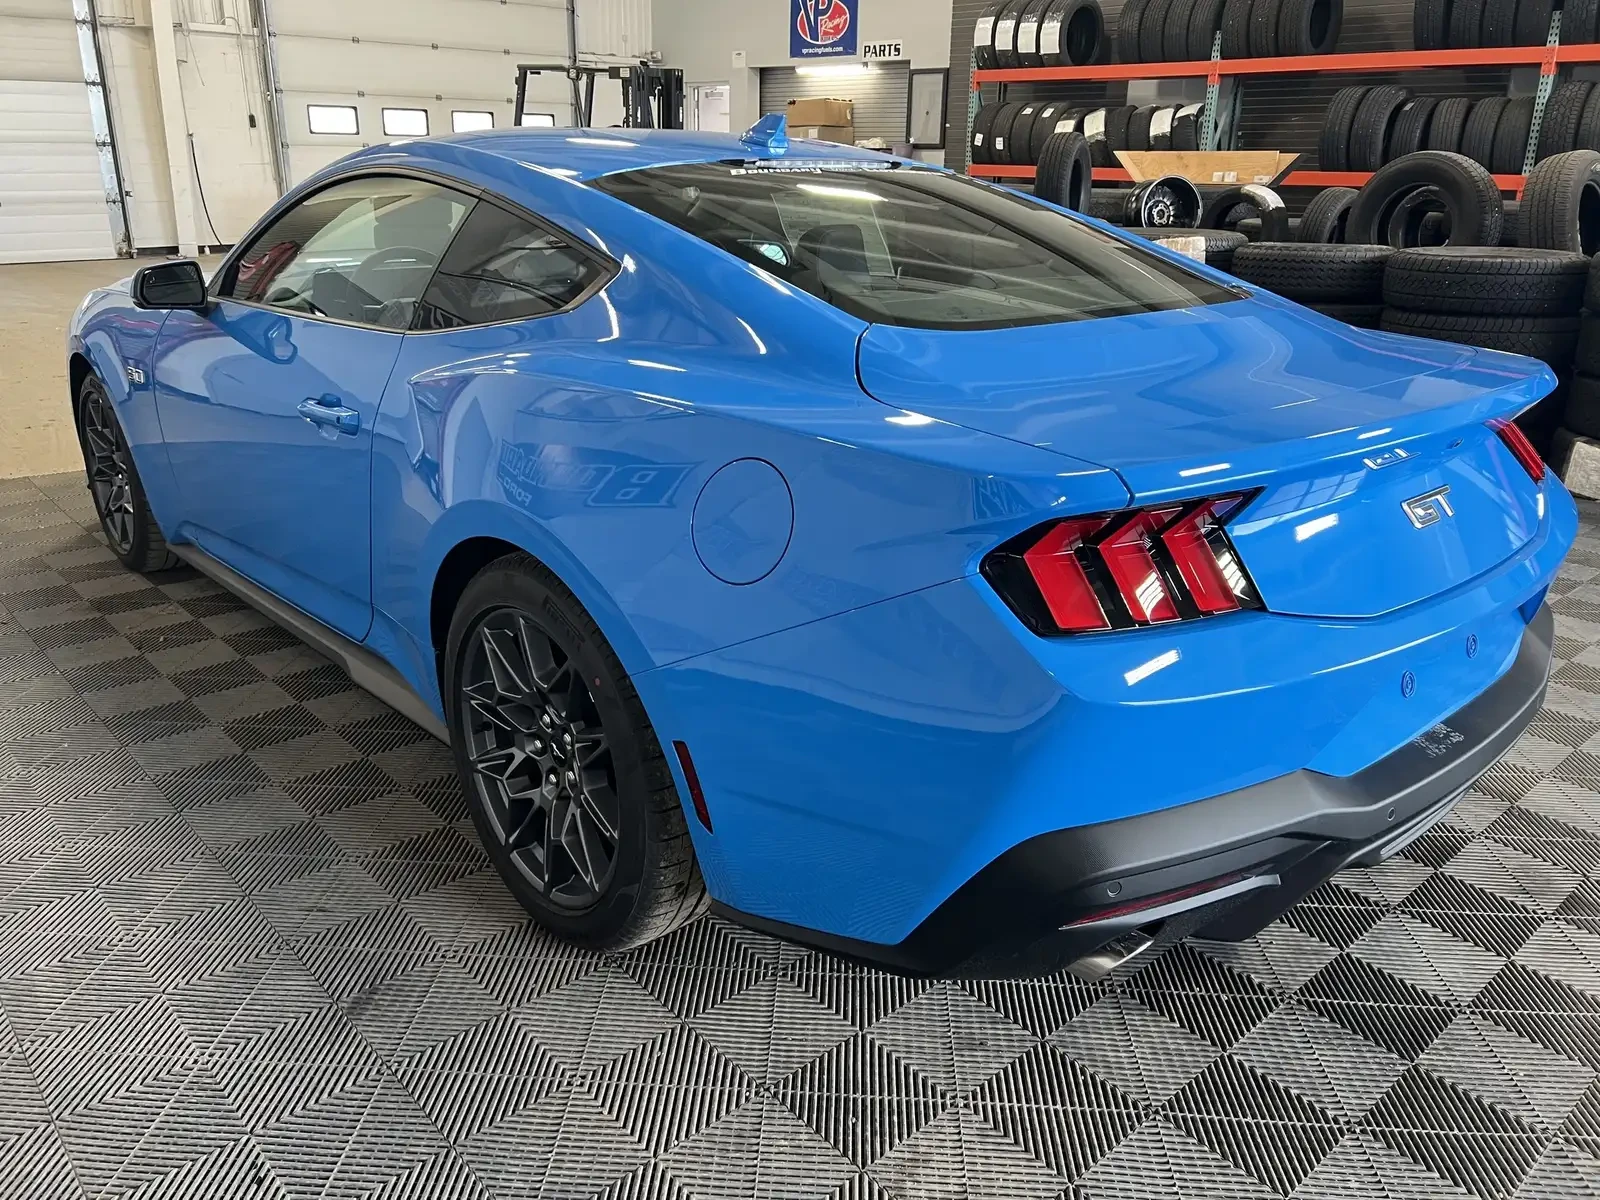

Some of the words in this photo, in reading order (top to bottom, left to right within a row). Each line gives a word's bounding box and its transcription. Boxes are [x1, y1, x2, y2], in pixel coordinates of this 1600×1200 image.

[820, 14, 848, 35] Racing
[863, 43, 901, 59] PARTS
[1400, 484, 1454, 529] GT
